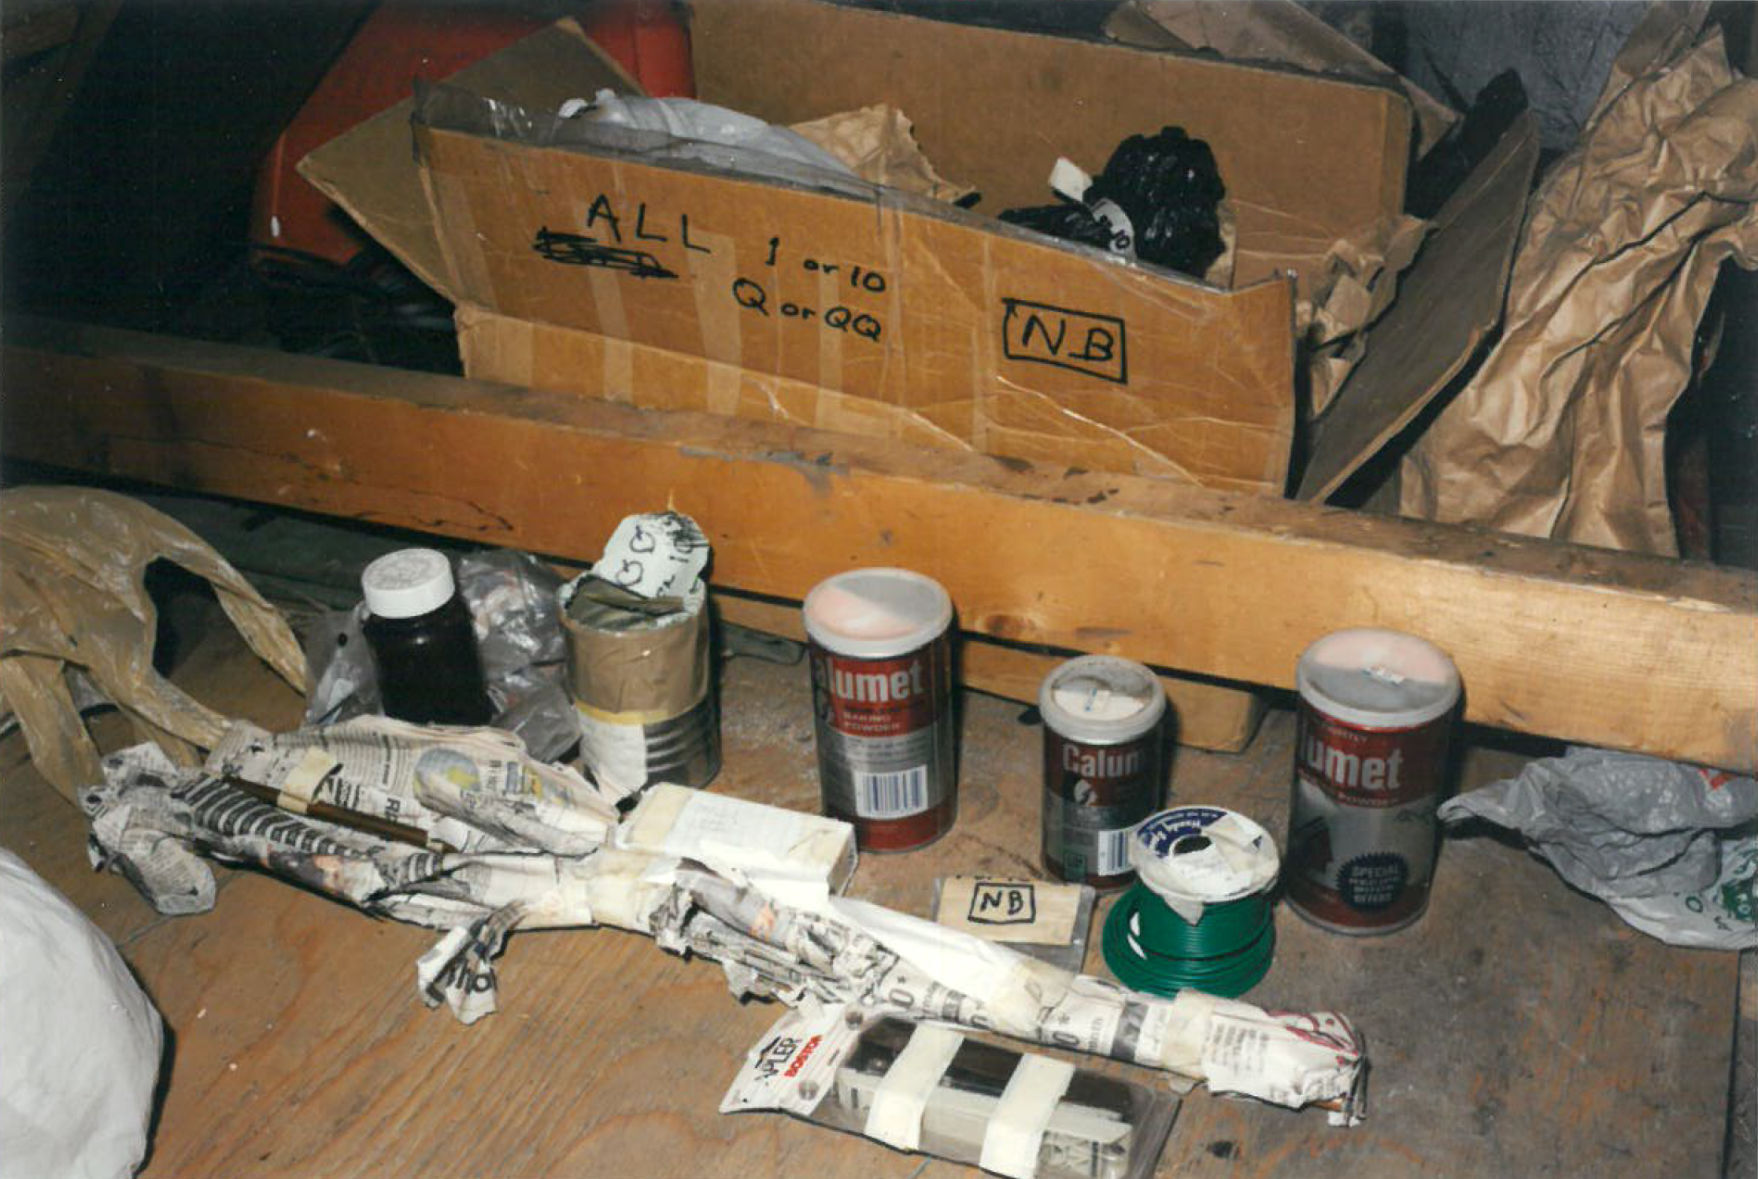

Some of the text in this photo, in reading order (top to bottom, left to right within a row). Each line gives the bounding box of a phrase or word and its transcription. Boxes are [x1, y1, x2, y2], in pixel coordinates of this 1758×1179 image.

[586, 194, 712, 253] ALL
[764, 236, 885, 292] 1 or 10
[733, 277, 882, 342] Q or QQ
[980, 889, 1024, 915] NB
